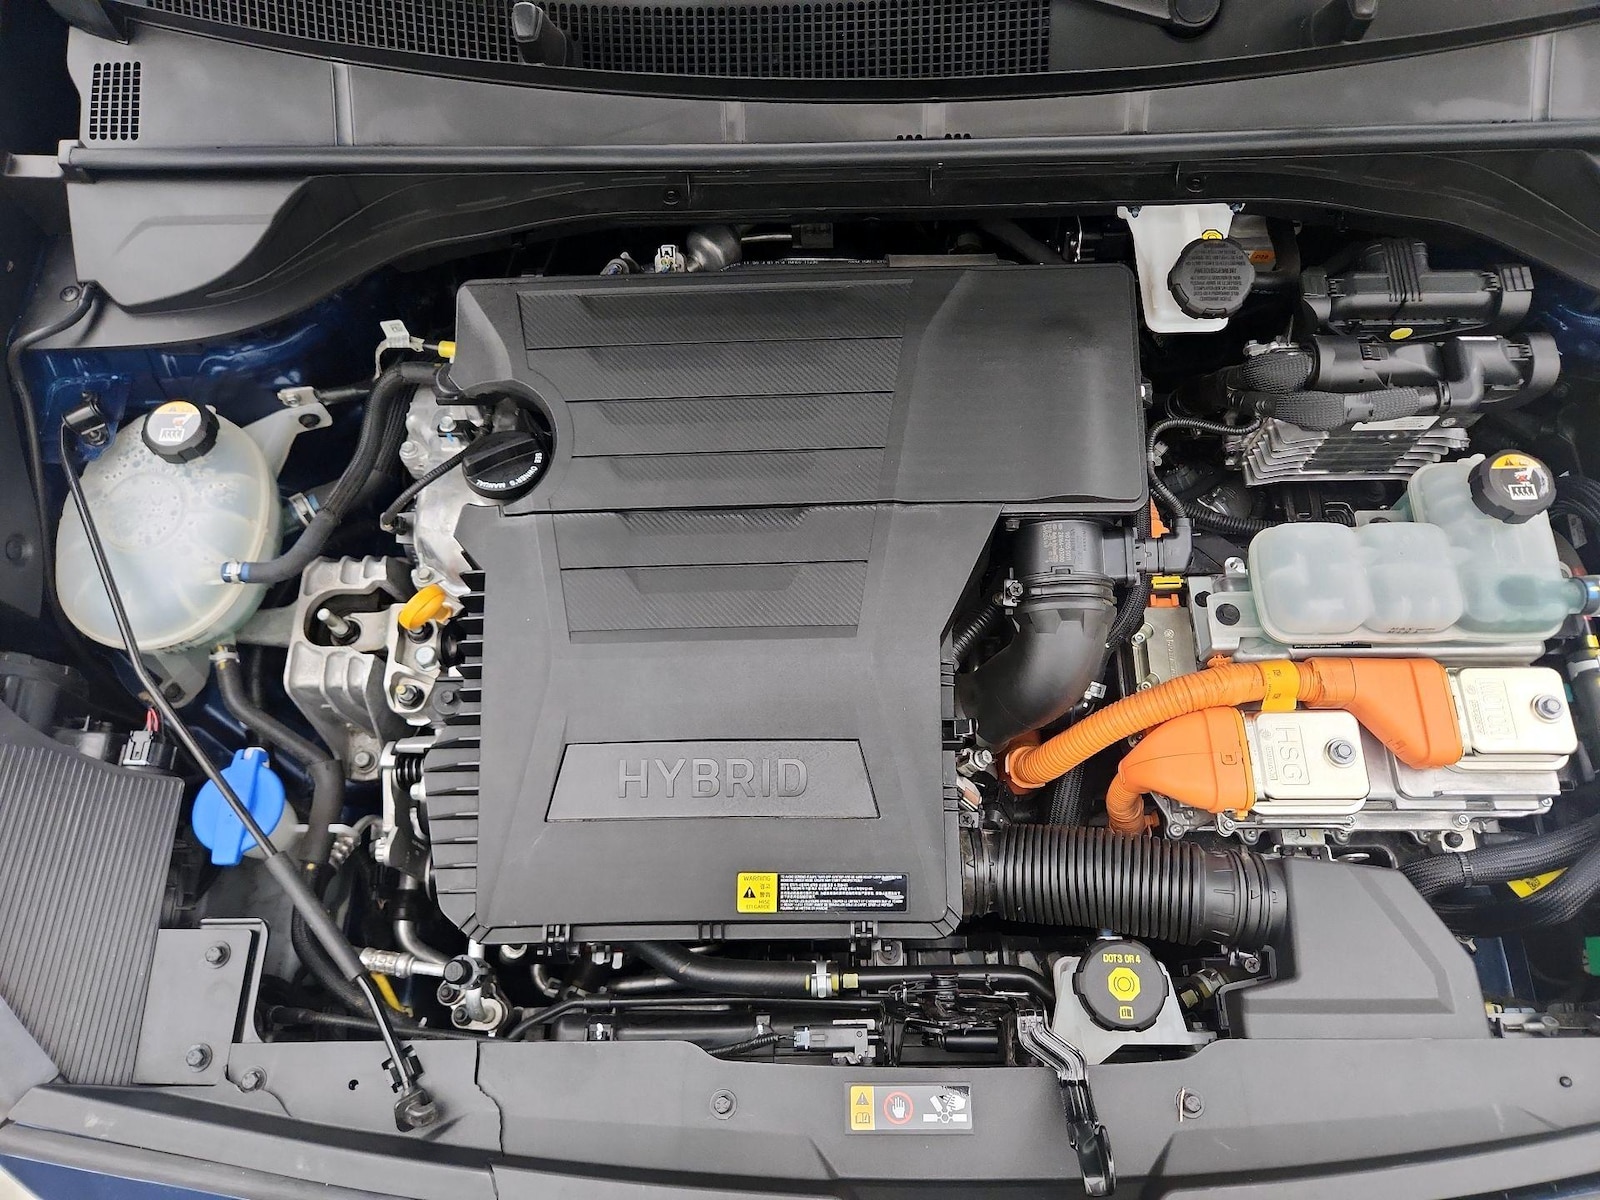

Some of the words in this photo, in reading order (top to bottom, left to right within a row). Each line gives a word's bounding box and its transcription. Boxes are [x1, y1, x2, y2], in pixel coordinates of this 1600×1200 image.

[534, 453, 542, 463] SEE
[509, 466, 538, 486] OWNER'S
[476, 480, 506, 488] MANUAL
[1275, 727, 1303, 780] HSG
[617, 758, 809, 798] HYBRID
[1103, 954, 1123, 963] DOT3
[1124, 954, 1135, 964] OR
[1135, 954, 1141, 964] 4
